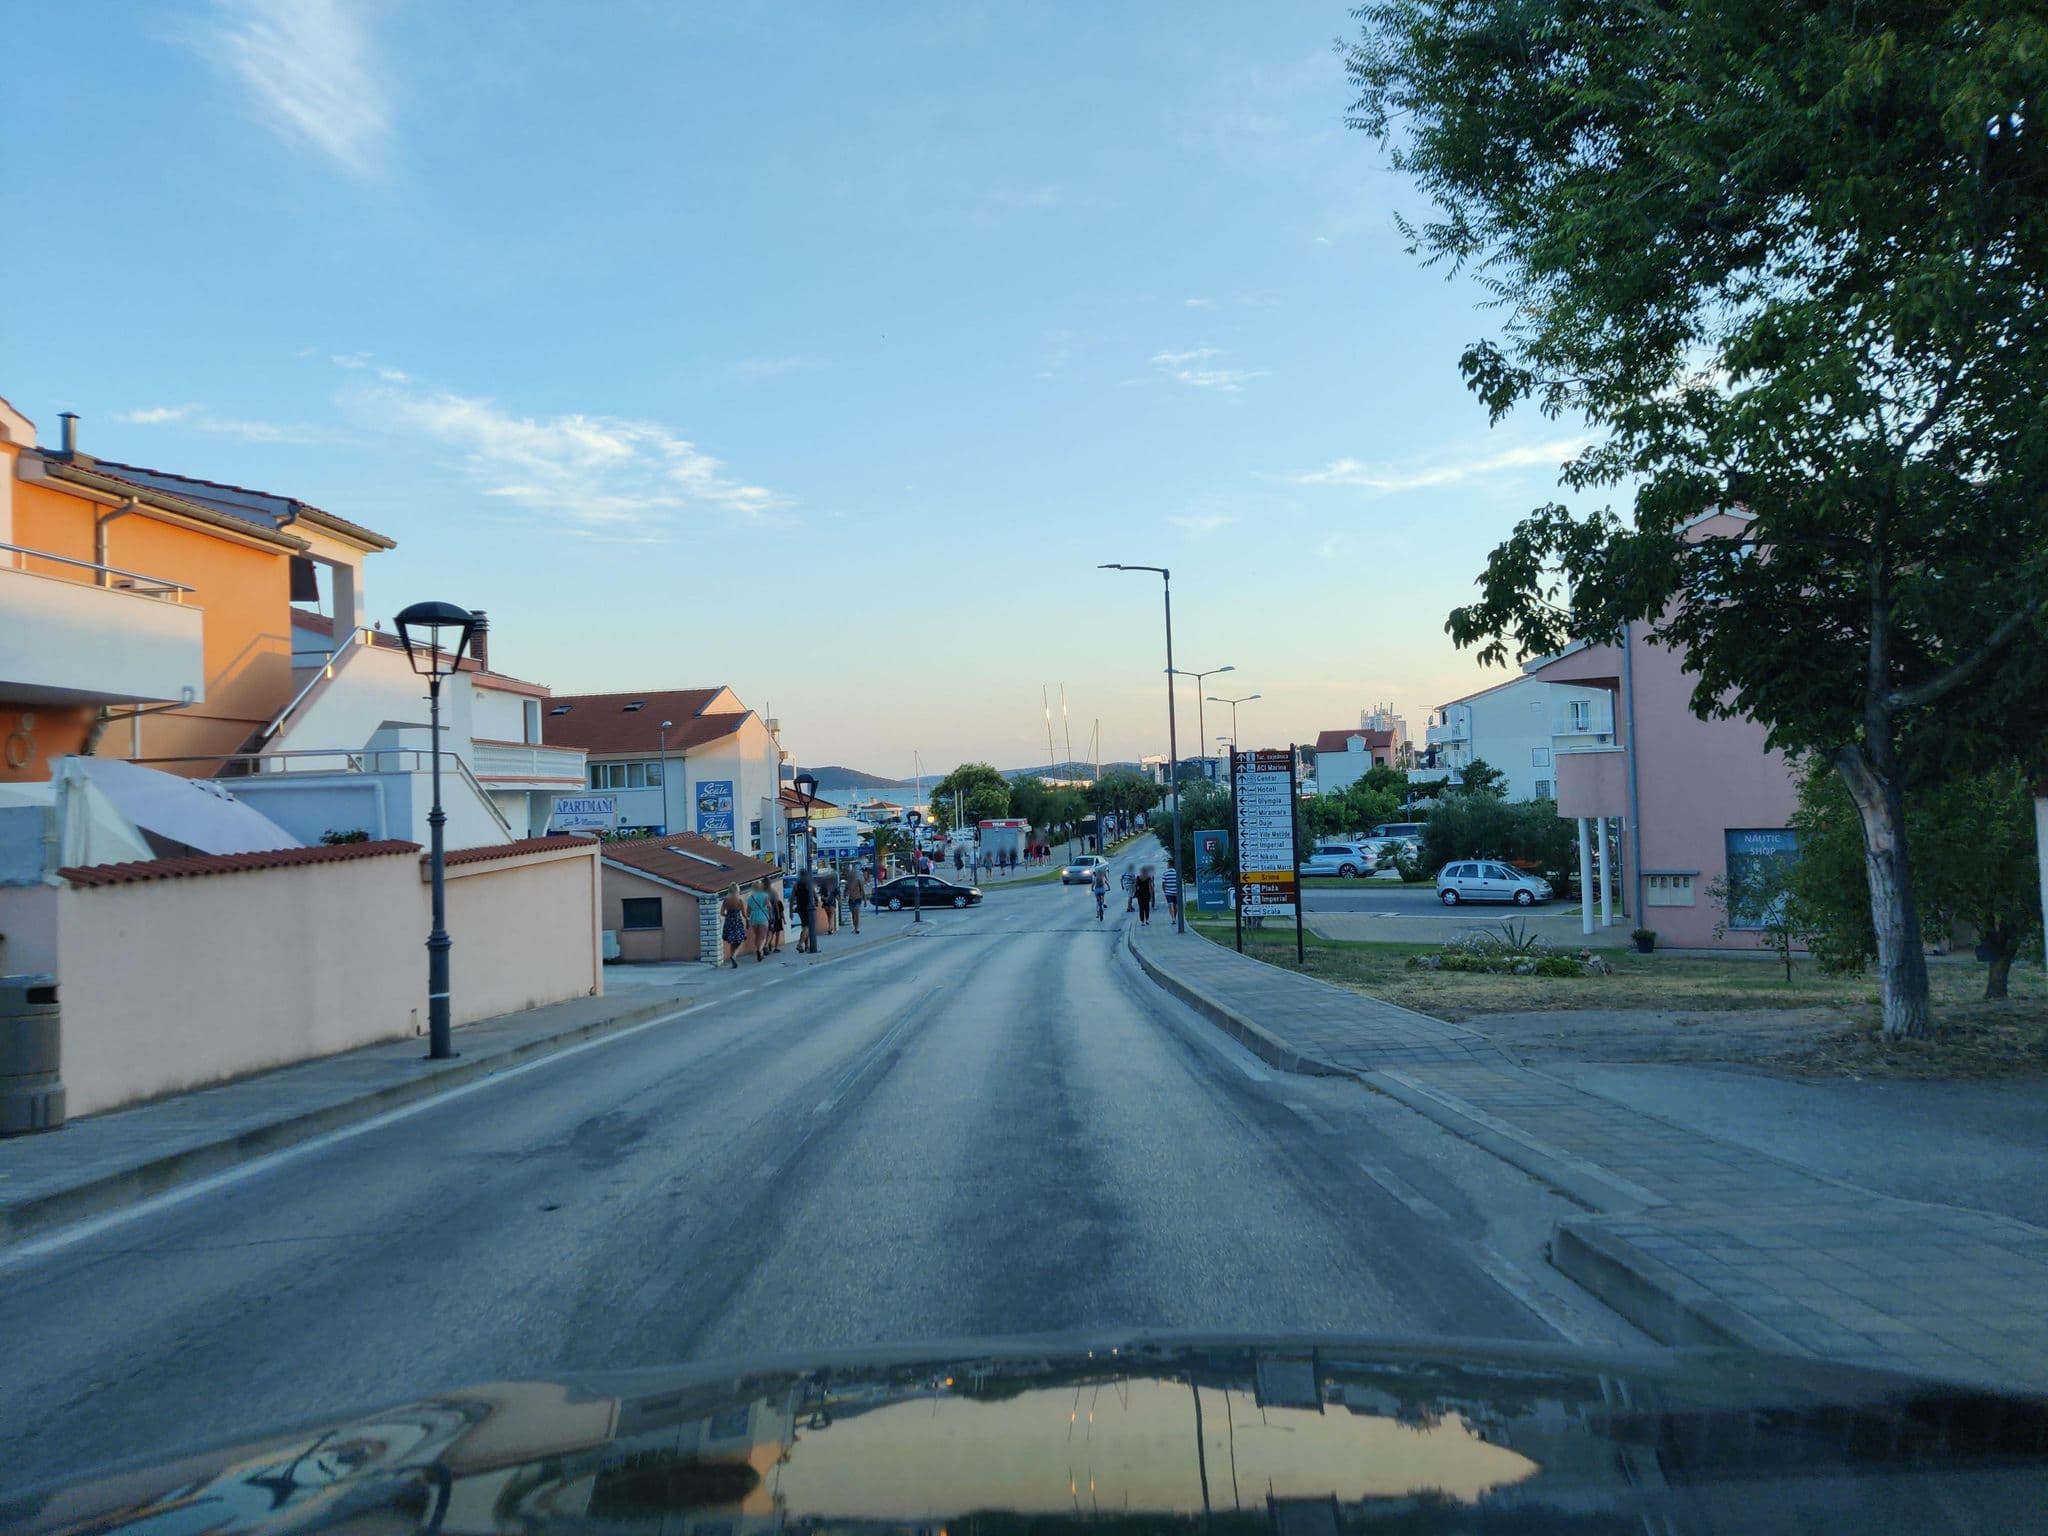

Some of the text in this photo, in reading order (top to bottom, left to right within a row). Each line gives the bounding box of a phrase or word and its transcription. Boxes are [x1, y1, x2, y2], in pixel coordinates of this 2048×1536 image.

[556, 799, 613, 813] APARTMANI
[1258, 819, 1273, 827] Duje
[1744, 834, 1781, 843] NAUTIC
[1750, 847, 1776, 856] SHOP
[1261, 895, 1287, 903] Imperial
